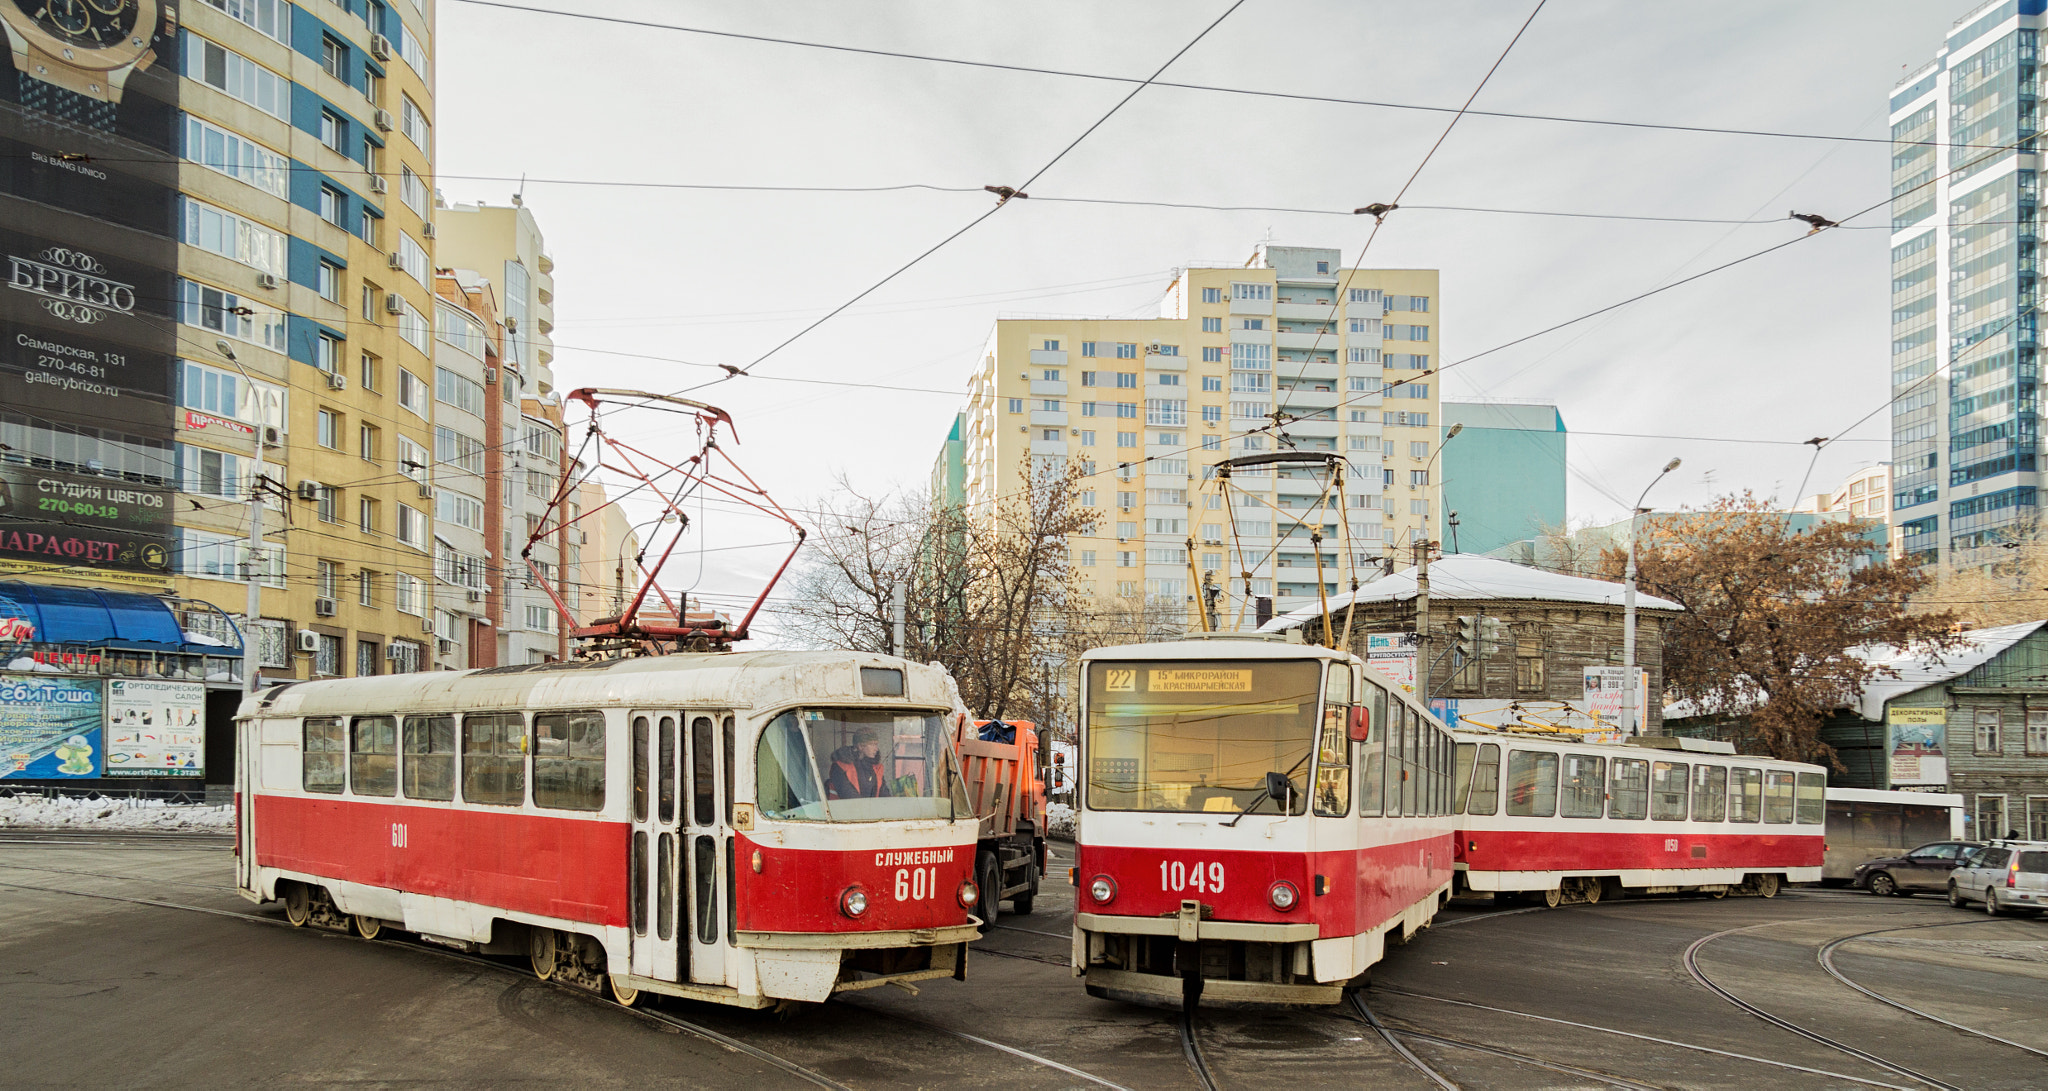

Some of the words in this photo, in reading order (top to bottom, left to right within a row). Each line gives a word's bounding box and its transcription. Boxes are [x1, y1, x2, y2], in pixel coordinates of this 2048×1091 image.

[32, 152, 48, 163] BIG
[49, 158, 76, 171] BANG
[77, 165, 107, 180] UNICO
[9, 260, 135, 311] БРИЗО
[17, 334, 99, 362] Самарская,
[104, 352, 126, 366] 131
[38, 355, 105, 378] 270-46-81
[25, 371, 119, 397] gallerybrizo.ru
[38, 478, 102, 499] СТУДИЯ
[107, 488, 164, 508] ЦВЕТОВ
[38, 497, 118, 519] 270-60-18
[33, 651, 101, 665] ЦЕНТР
[1109, 670, 1131, 689] 22
[1163, 681, 1245, 690] КРАСНОАРМЕЙСКАЯ
[1175, 670, 1239, 680] МИКРОРАЙОН
[175, 693, 203, 701] САЛОН
[17, 761, 25, 770] 2
[392, 822, 407, 848] 601
[1664, 839, 1678, 852] 1050
[875, 847, 954, 867] СЛУЖЕБНЫЙ
[894, 867, 936, 902] 601
[1160, 860, 1225, 894] 1049
